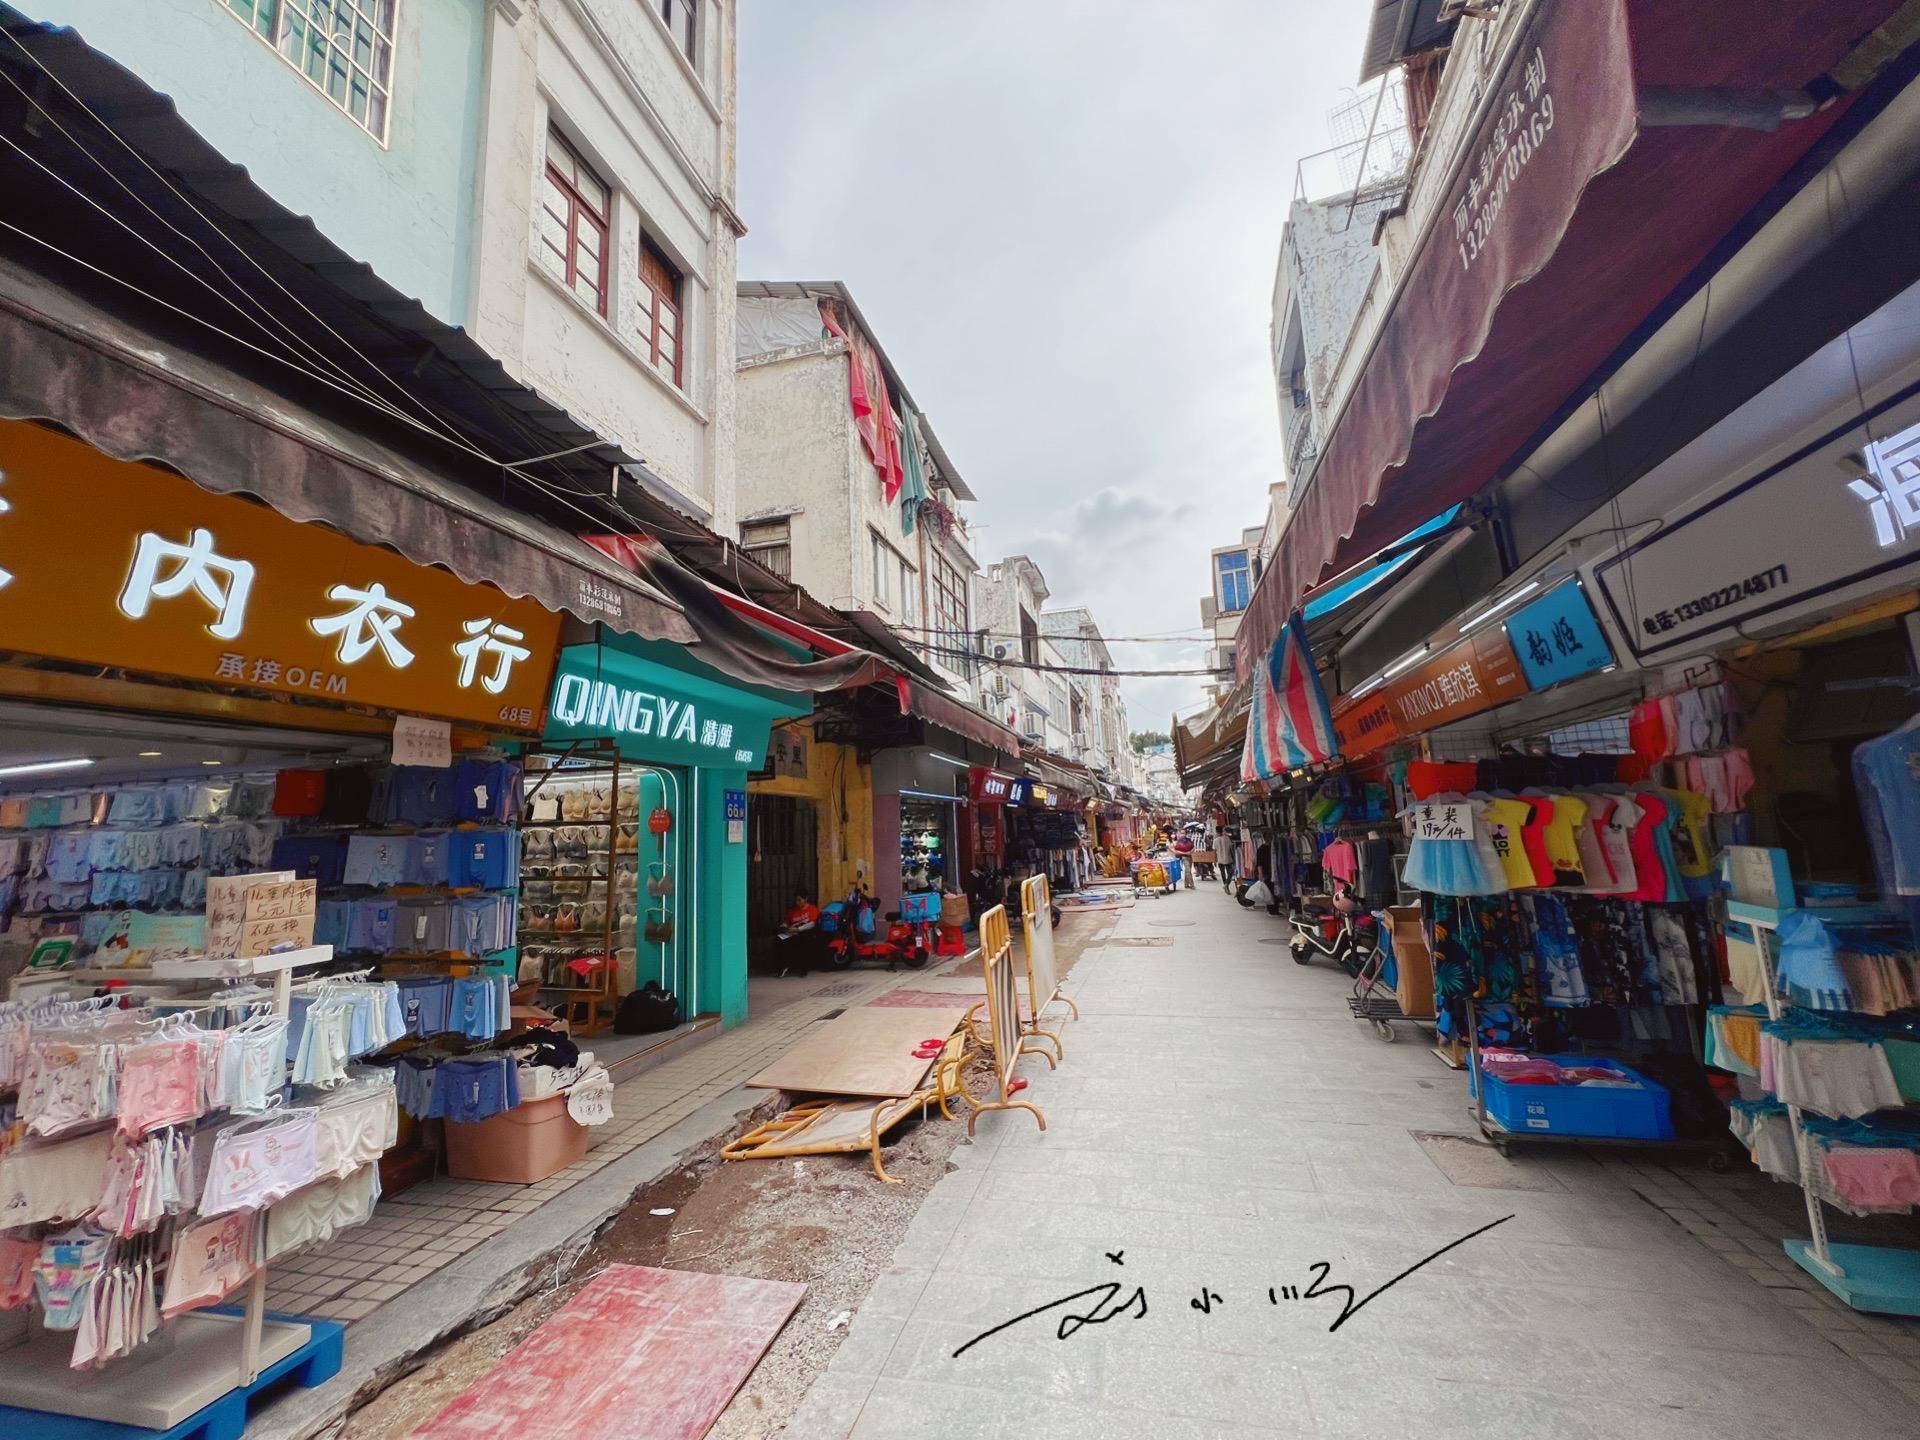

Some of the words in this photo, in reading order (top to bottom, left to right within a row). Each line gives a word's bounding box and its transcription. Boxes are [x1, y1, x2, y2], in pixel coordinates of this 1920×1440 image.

[1458, 93, 1555, 271] 13286818869
[118, 528, 531, 694] 内衣行
[215, 652, 348, 695] 承接OEM
[499, 706, 532, 727] 68号
[552, 672, 697, 744] QINGYA
[702, 719, 733, 749] 清雅
[1397, 680, 1444, 722] YAXINQI
[1420, 802, 1458, 823] 童装
